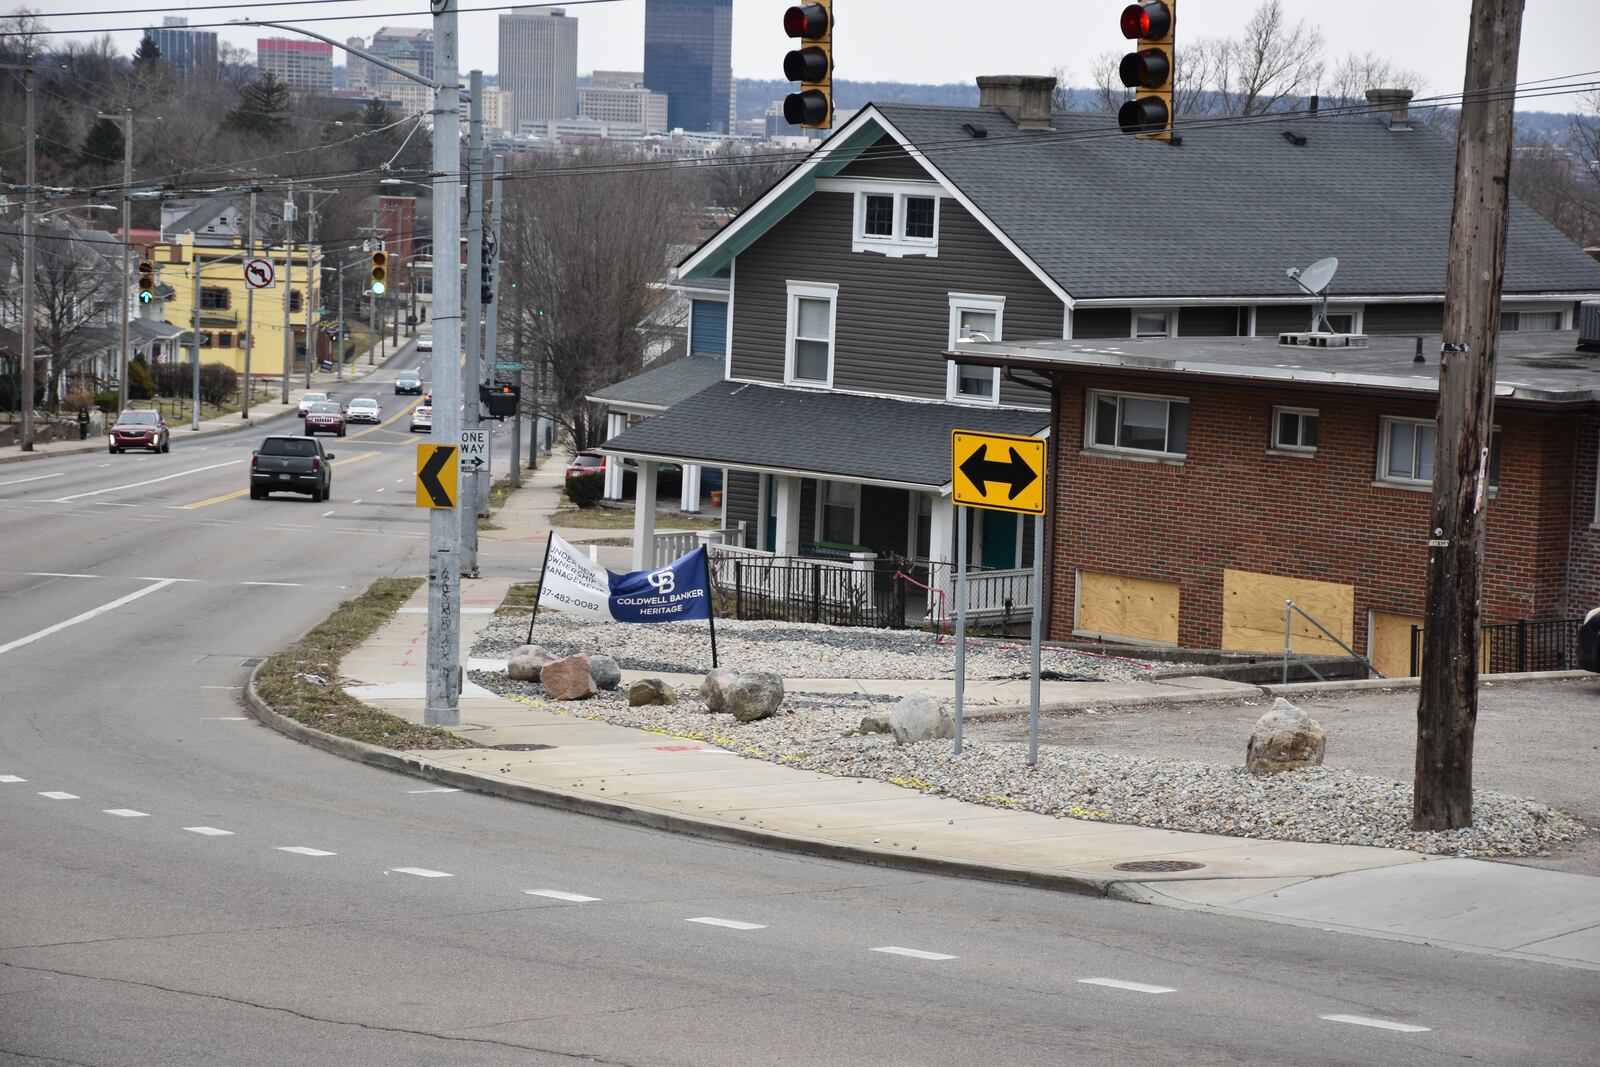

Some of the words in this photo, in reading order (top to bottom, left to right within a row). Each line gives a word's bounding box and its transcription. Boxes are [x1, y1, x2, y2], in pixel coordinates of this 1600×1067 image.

[461, 432, 484, 443] ONE
[460, 444, 485, 454] WAY
[617, 596, 667, 605] COLDWELL
[669, 589, 704, 603] BANKER
[640, 604, 683, 615] HERITAGE
